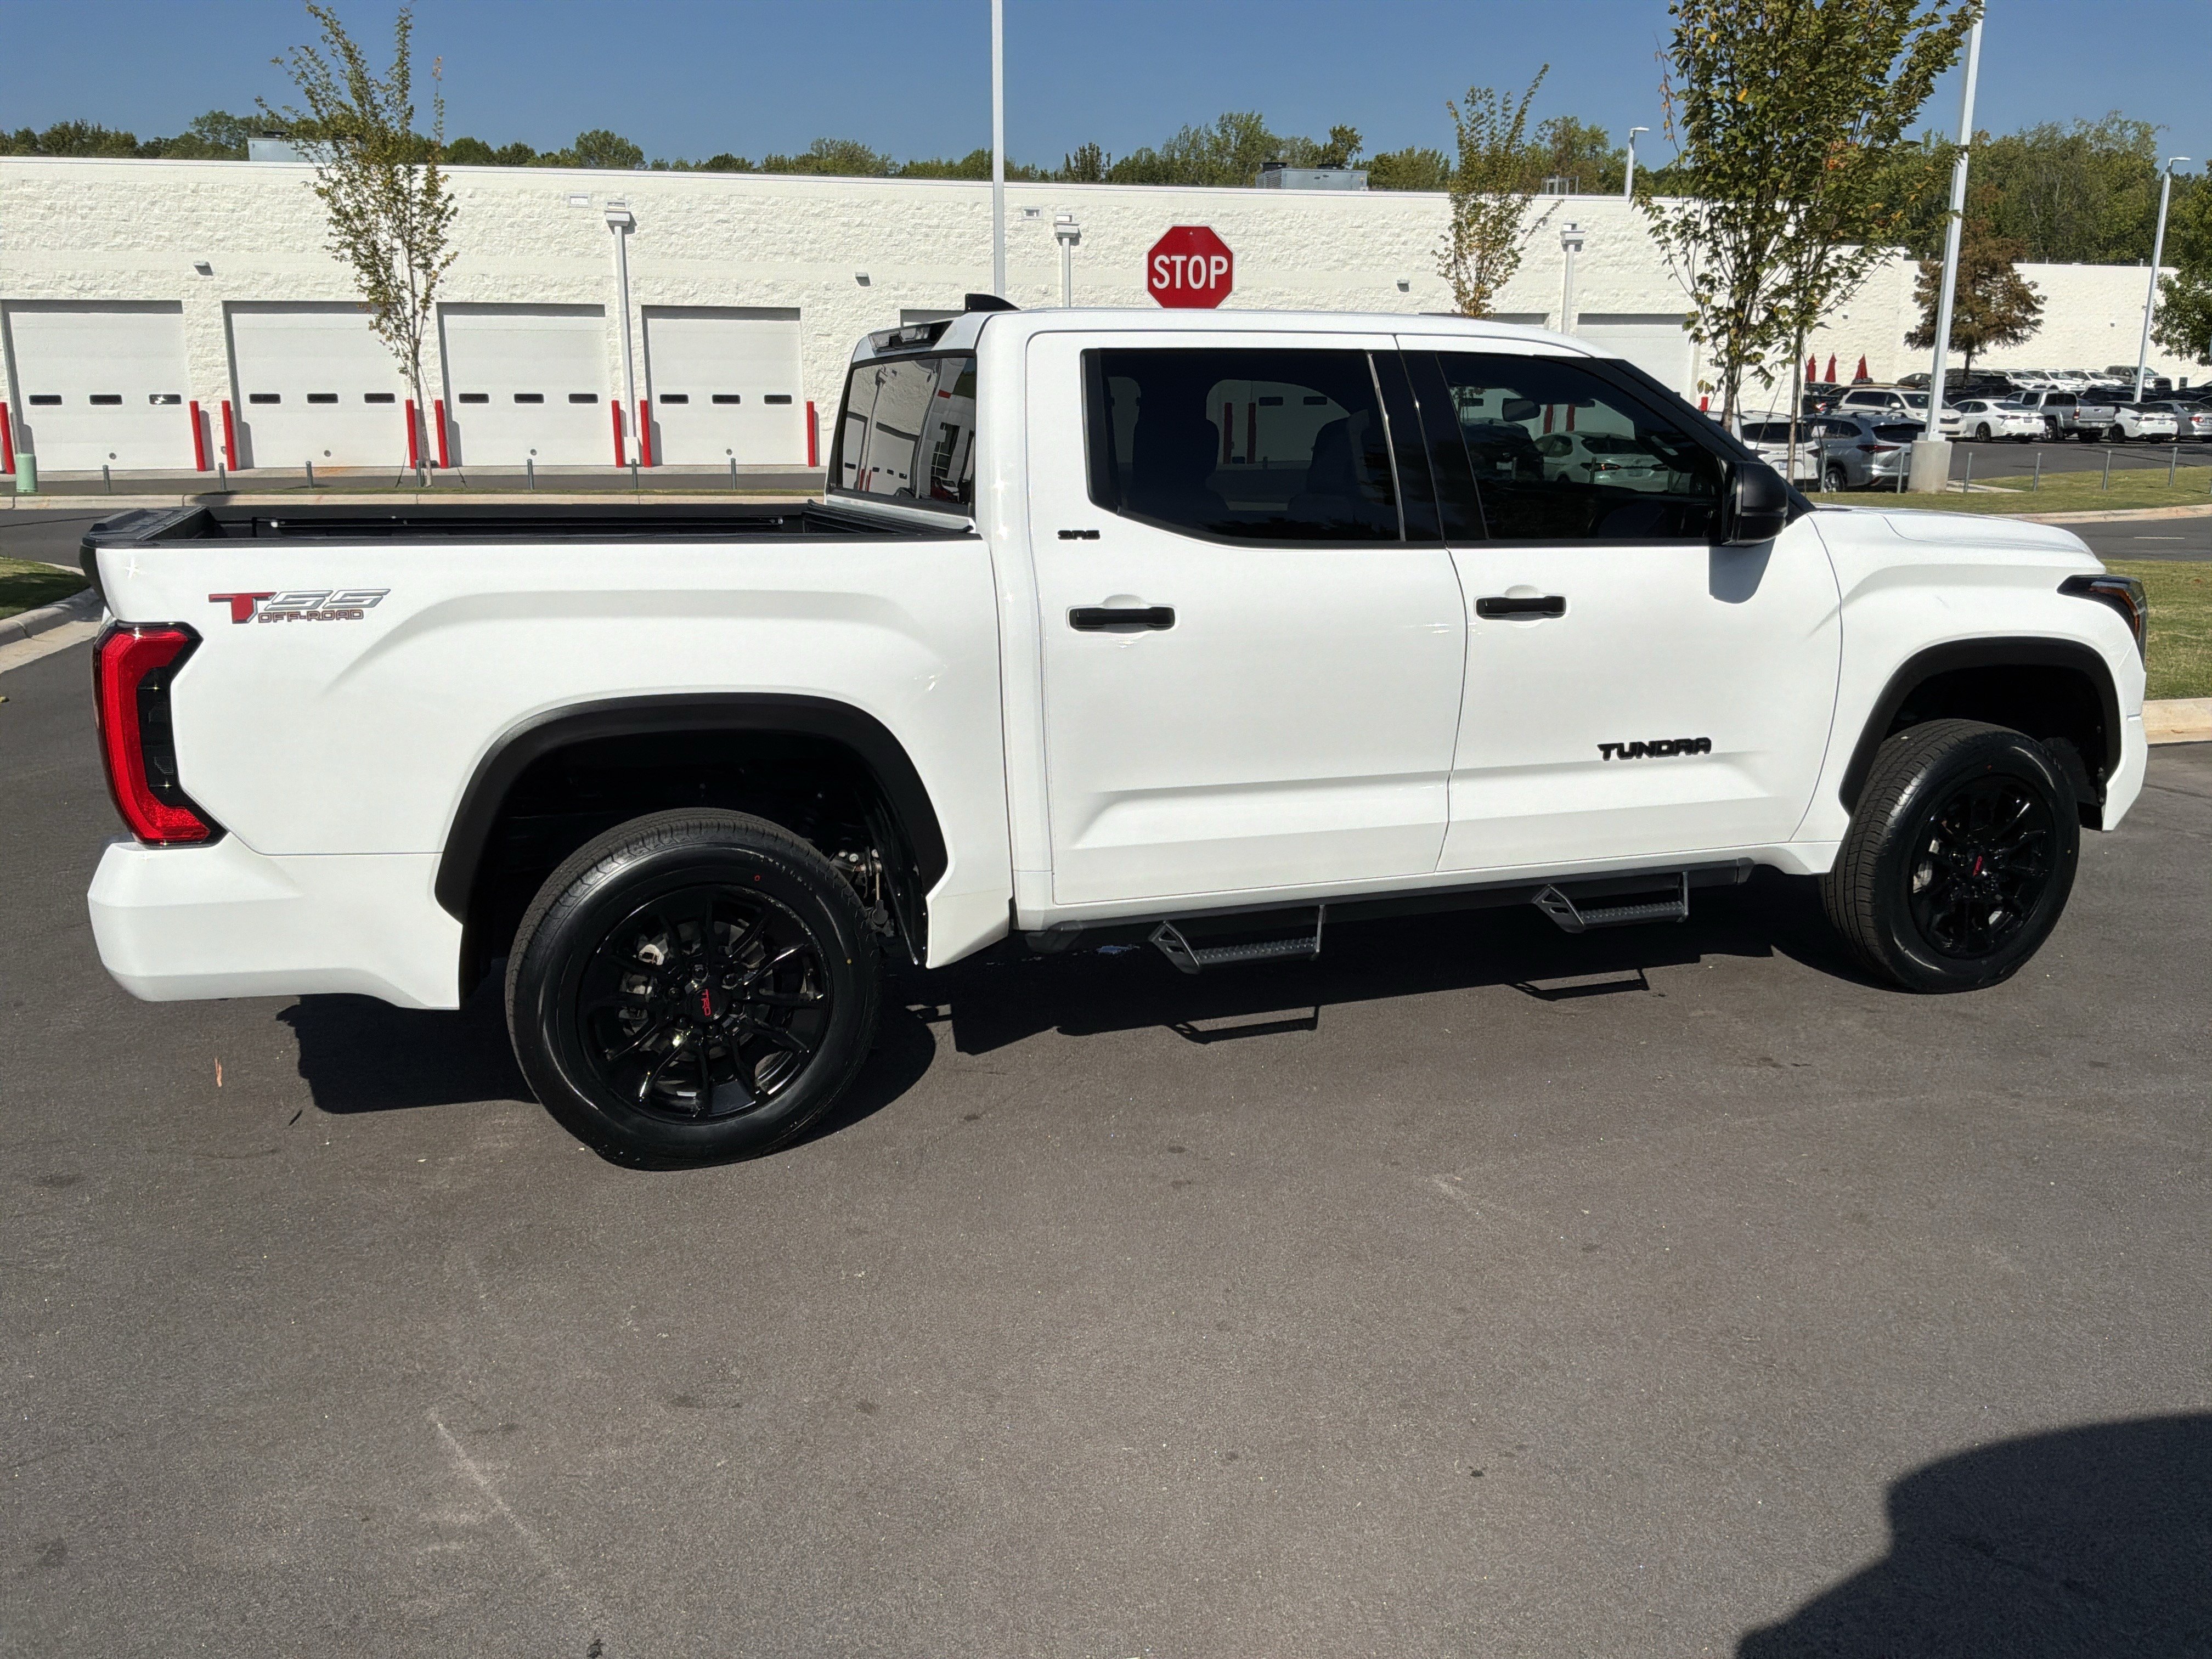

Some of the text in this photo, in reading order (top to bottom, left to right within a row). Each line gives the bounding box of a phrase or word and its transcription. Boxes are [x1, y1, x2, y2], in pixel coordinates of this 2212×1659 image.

[1152, 255, 1228, 290] STOP
[258, 610, 364, 623] OFF-ROAD
[1597, 737, 1712, 761] TUNDRA
